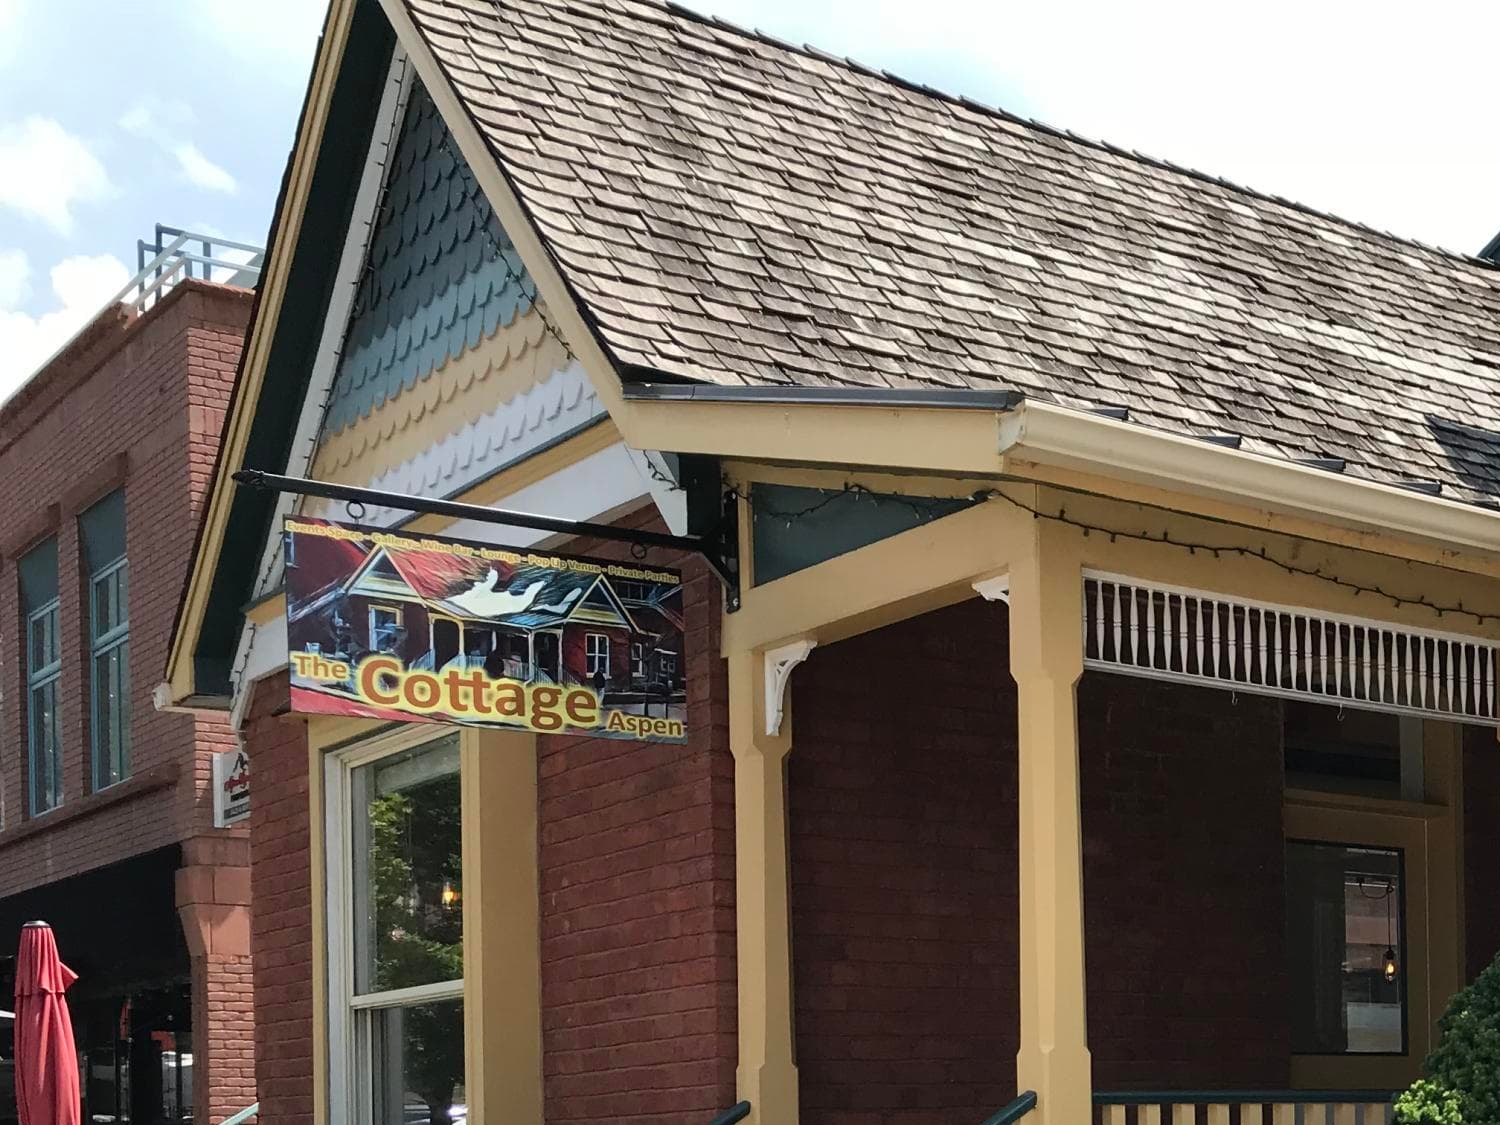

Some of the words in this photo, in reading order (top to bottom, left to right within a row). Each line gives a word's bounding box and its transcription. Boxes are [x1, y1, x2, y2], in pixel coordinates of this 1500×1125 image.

[287, 521, 325, 535] Events
[327, 527, 363, 540] Space
[372, 533, 415, 550] Gallery
[421, 540, 452, 553] Wine
[453, 544, 473, 556] Bar
[481, 548, 520, 564] Lounge
[528, 555, 550, 568] Pop
[551, 558, 567, 570] Up
[568, 560, 601, 573] Venue
[608, 565, 645, 579] Private
[645, 571, 679, 584] Parties
[294, 655, 347, 680] The
[360, 658, 598, 730] Cottage
[608, 711, 683, 737] Aspen
